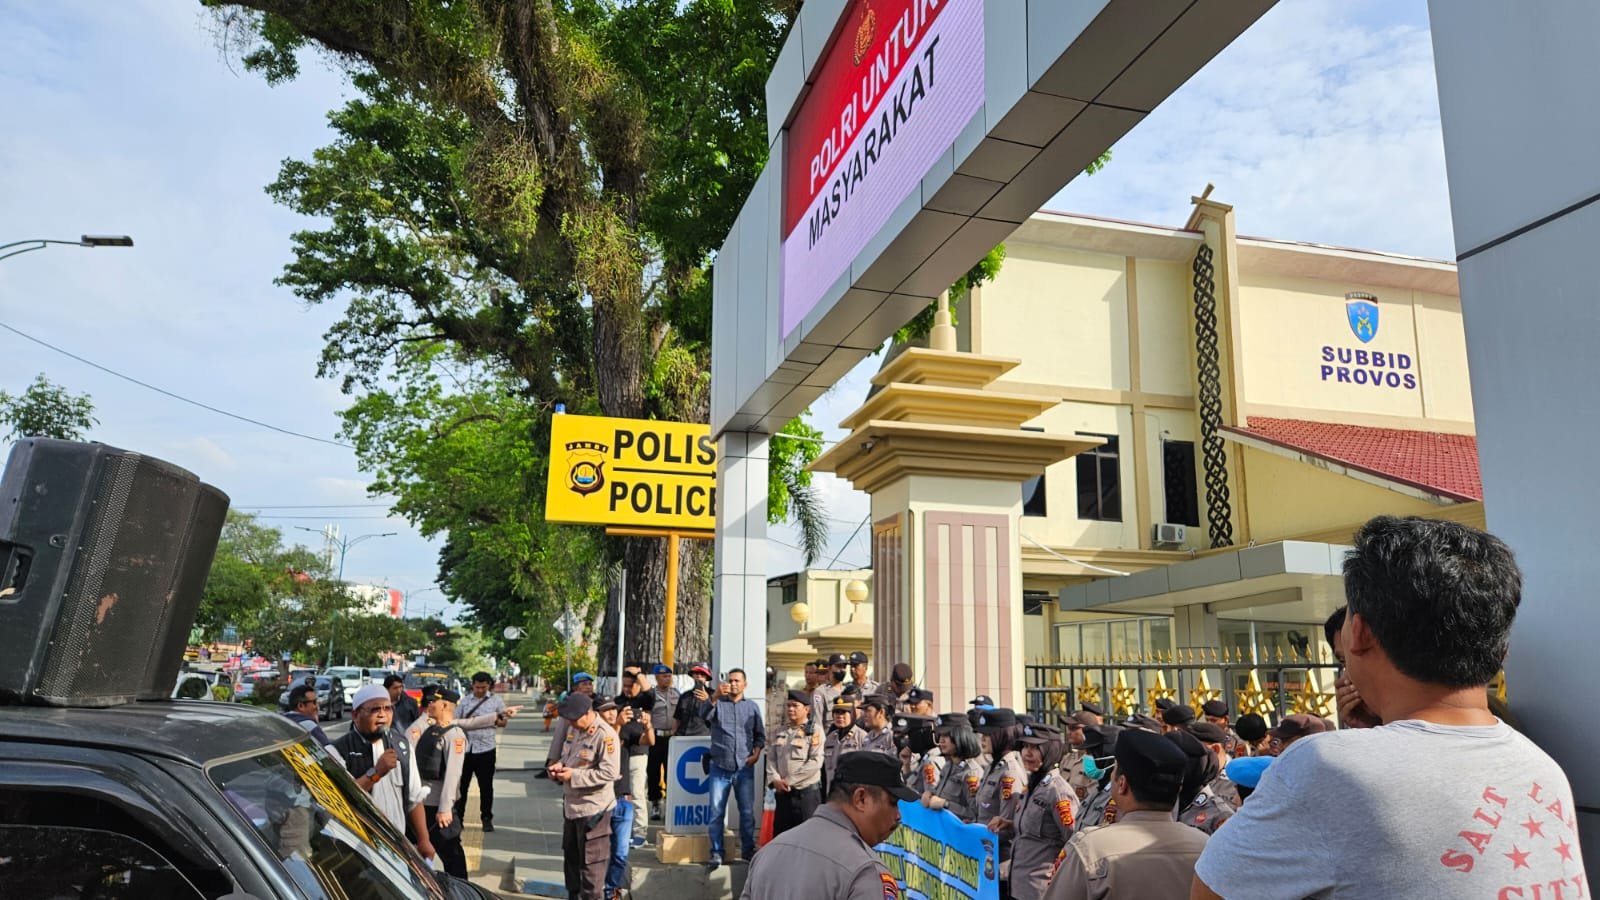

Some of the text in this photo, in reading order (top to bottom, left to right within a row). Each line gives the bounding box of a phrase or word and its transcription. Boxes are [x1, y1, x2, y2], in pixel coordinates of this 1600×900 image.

[808, 33, 940, 250] MASYARAKAT
[809, 91, 858, 196] POLRI
[1320, 364, 1417, 390] PROVOS
[1321, 345, 1412, 370] SUBBID
[1439, 785, 1509, 873] SALT
[1497, 873, 1584, 900] CITY
